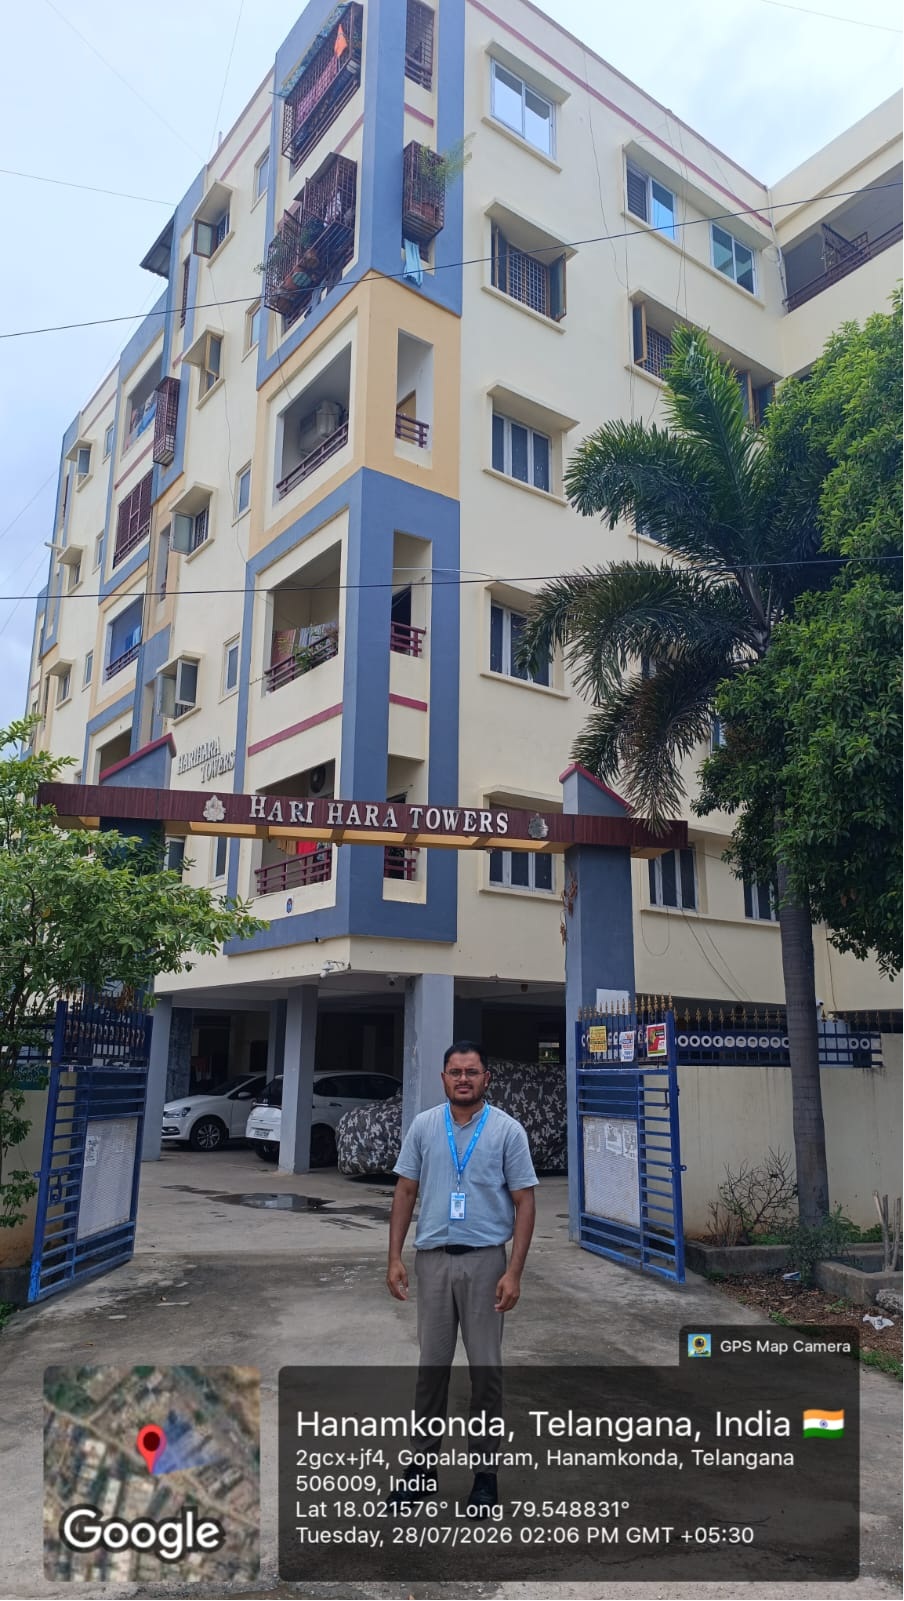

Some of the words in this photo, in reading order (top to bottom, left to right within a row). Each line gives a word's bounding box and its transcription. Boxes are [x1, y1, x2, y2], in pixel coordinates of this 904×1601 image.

[201, 751, 236, 784] TOWERS
[249, 795, 315, 824] HARI
[326, 802, 399, 828] HARA
[409, 807, 509, 834] TOWERS
